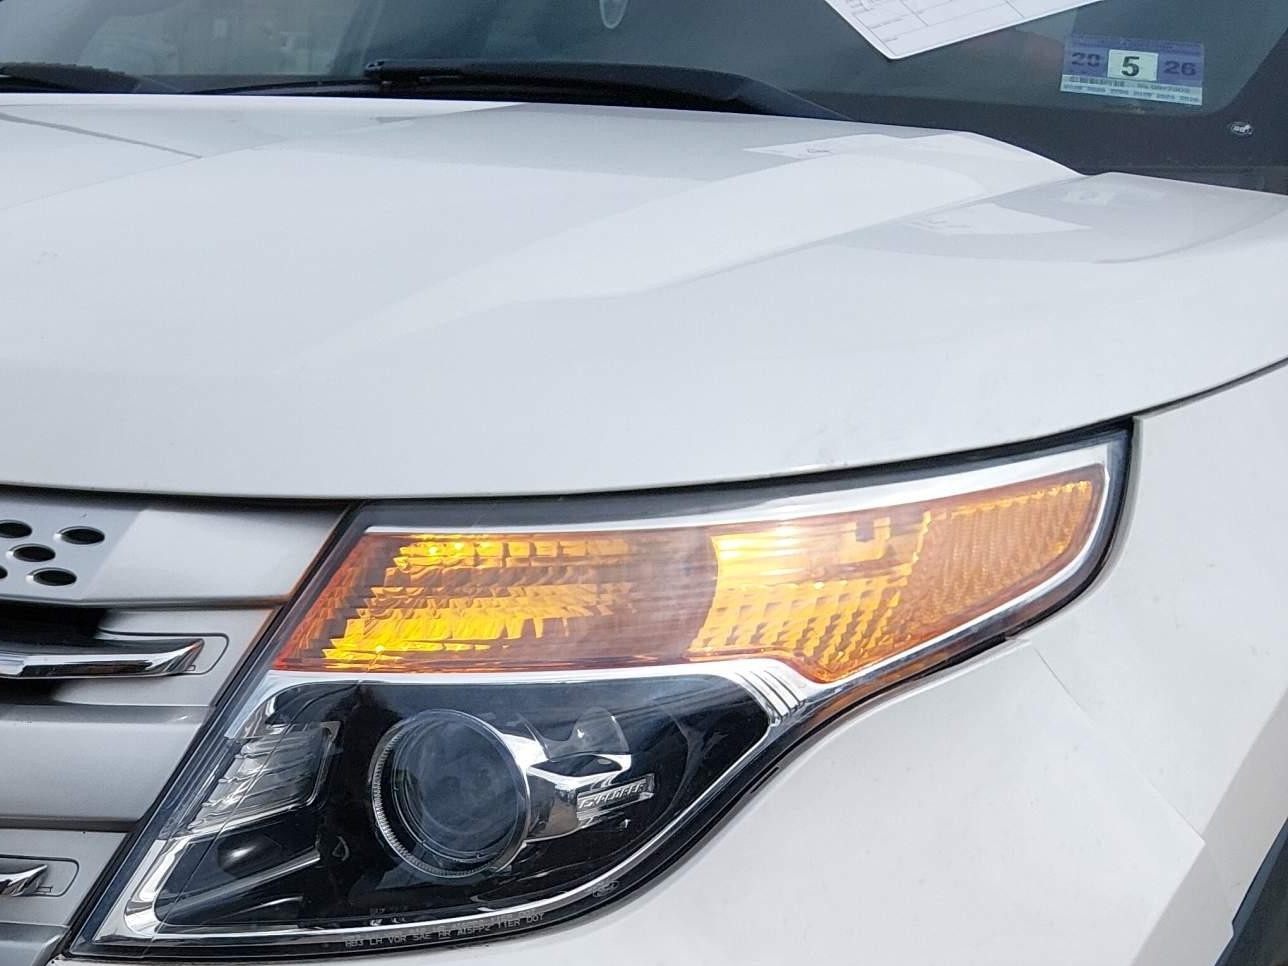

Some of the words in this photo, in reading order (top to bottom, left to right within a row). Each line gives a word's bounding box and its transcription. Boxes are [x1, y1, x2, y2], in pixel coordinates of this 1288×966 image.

[1120, 55, 1140, 77] 5
[1163, 60, 1197, 77] 26
[388, 934, 407, 944] VOR
